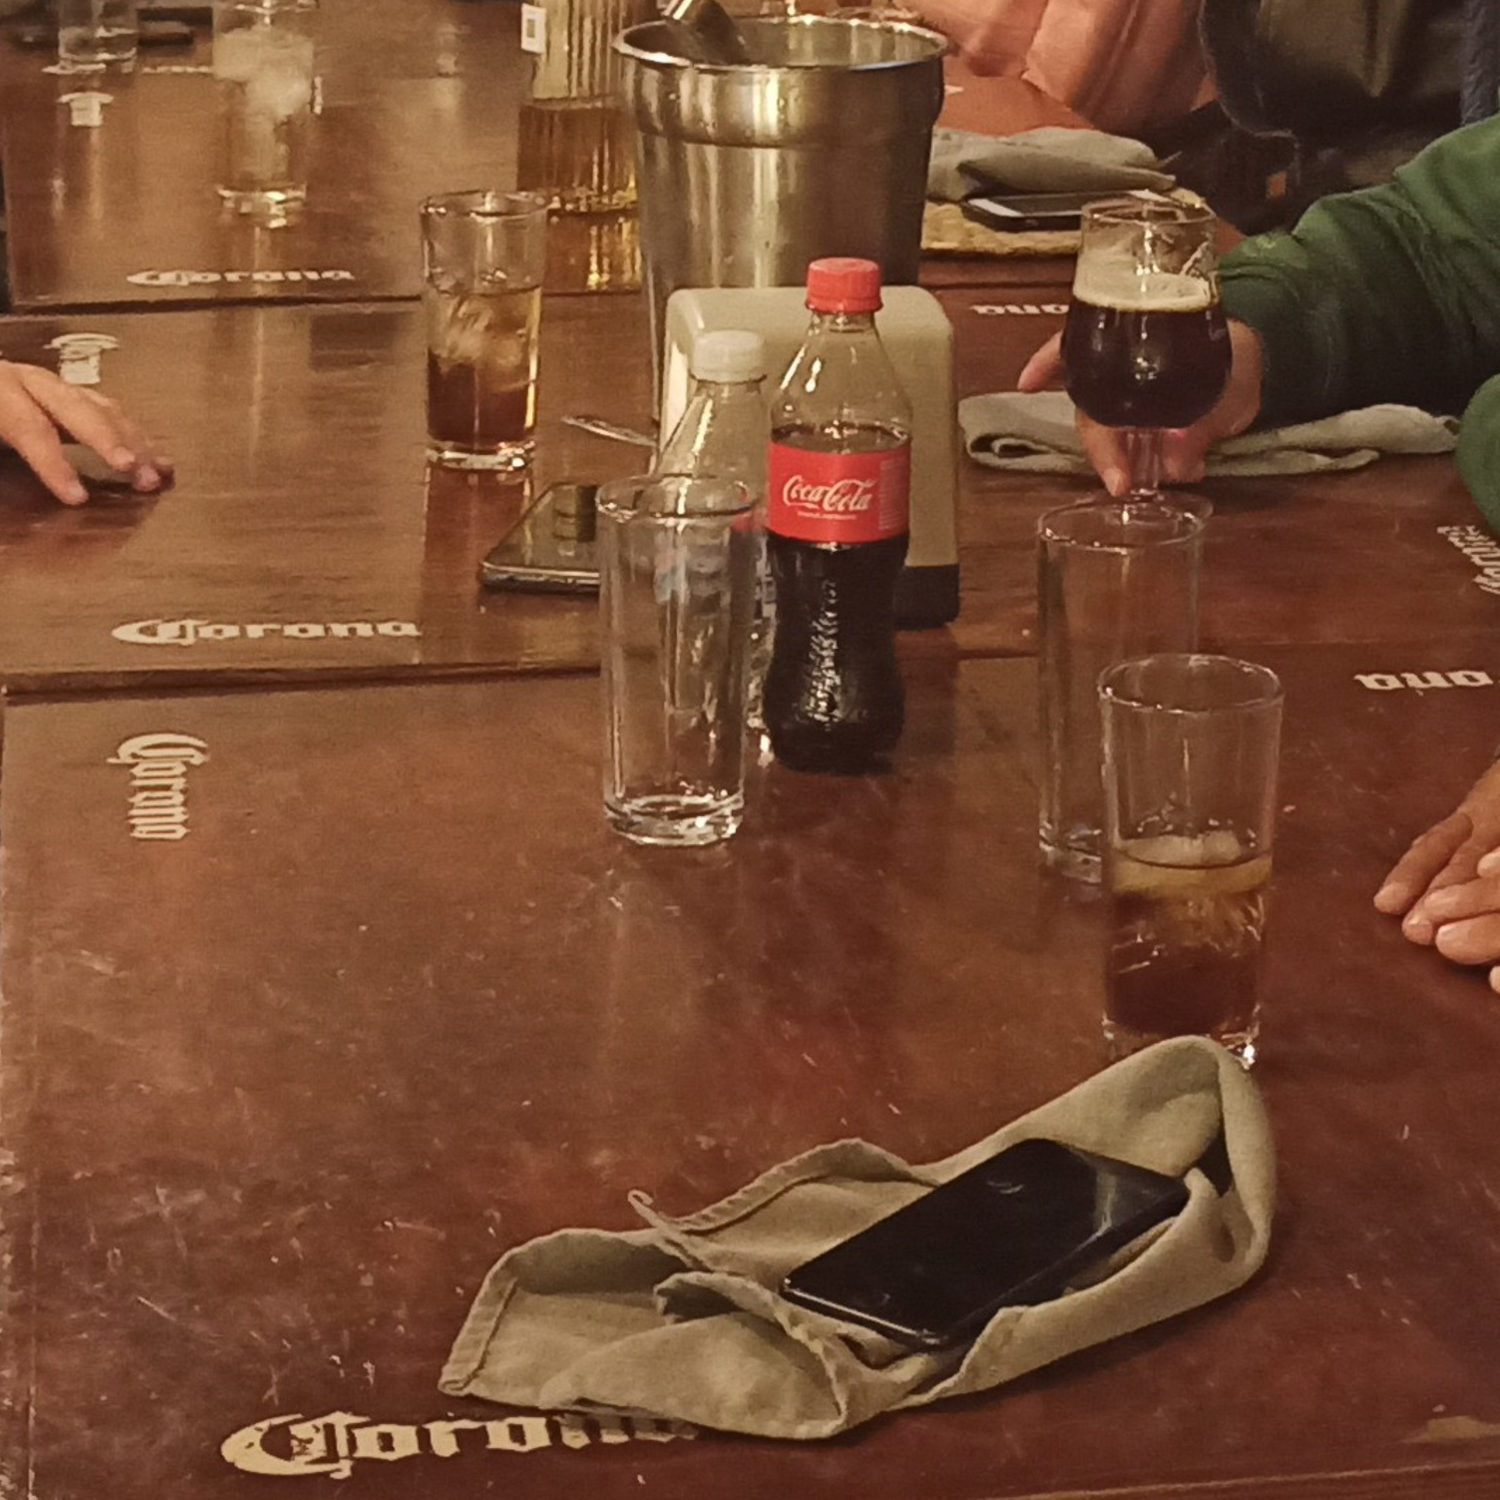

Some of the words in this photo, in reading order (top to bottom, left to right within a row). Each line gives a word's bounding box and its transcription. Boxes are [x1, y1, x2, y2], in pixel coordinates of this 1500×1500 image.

[782, 474, 878, 512] Coca-Cola
[111, 618, 422, 645] Corona
[1353, 670, 1494, 691] ona
[106, 732, 211, 840] Corona
